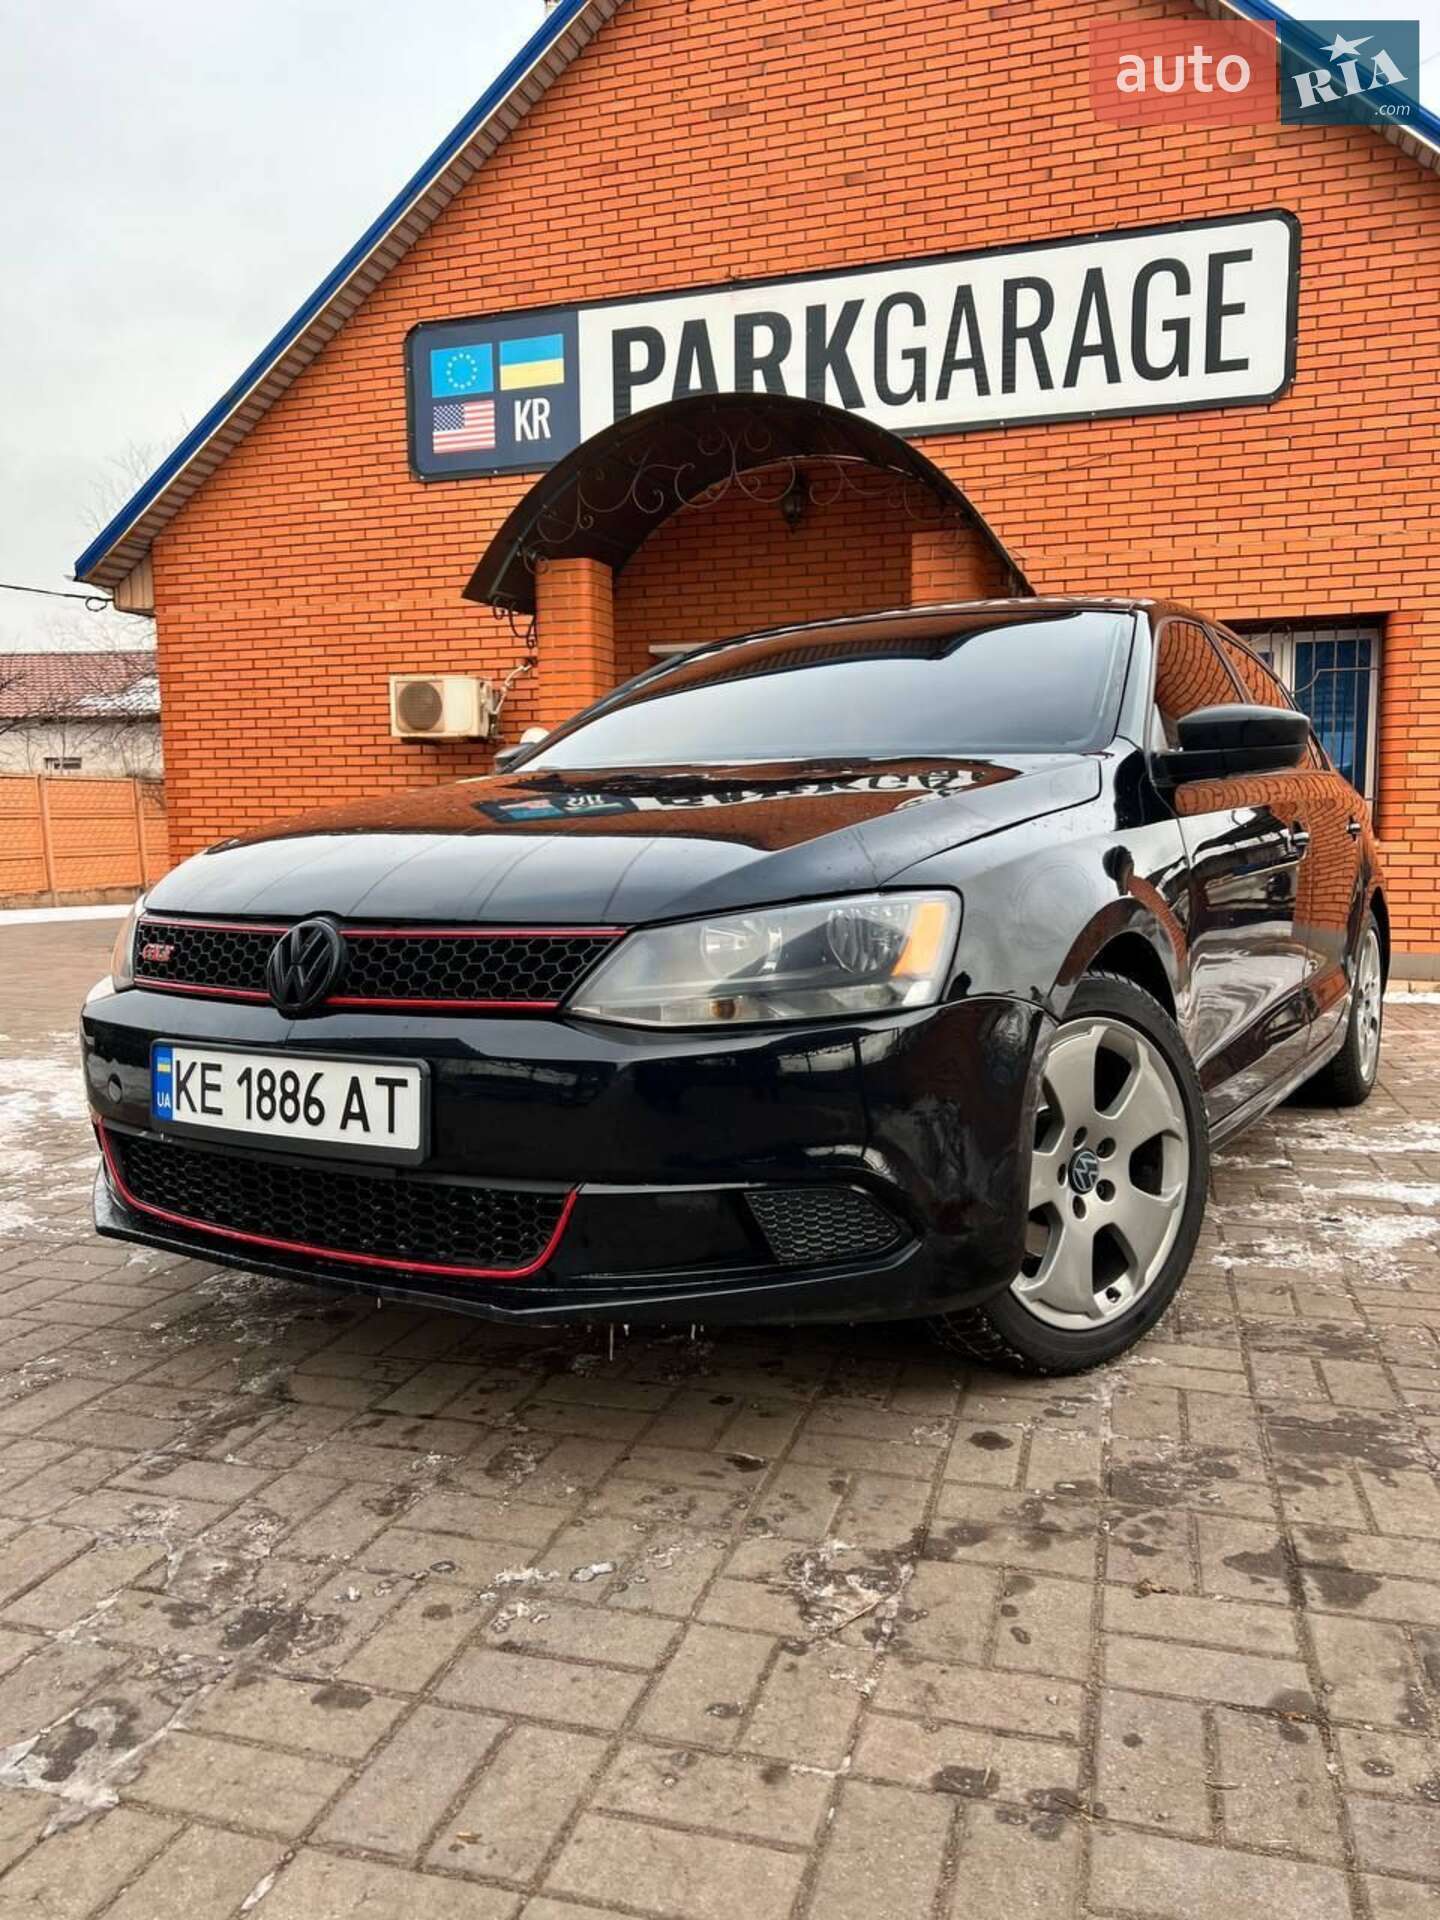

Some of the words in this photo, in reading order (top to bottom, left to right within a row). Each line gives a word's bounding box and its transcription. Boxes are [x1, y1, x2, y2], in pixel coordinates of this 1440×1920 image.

[611, 248, 1254, 424] PARKGARAGE
[514, 397, 551, 442] KR
[157, 1092, 171, 1108] UA
[175, 1060, 223, 1116] KE
[237, 1066, 325, 1126] 1886
[340, 1076, 408, 1133] AT
